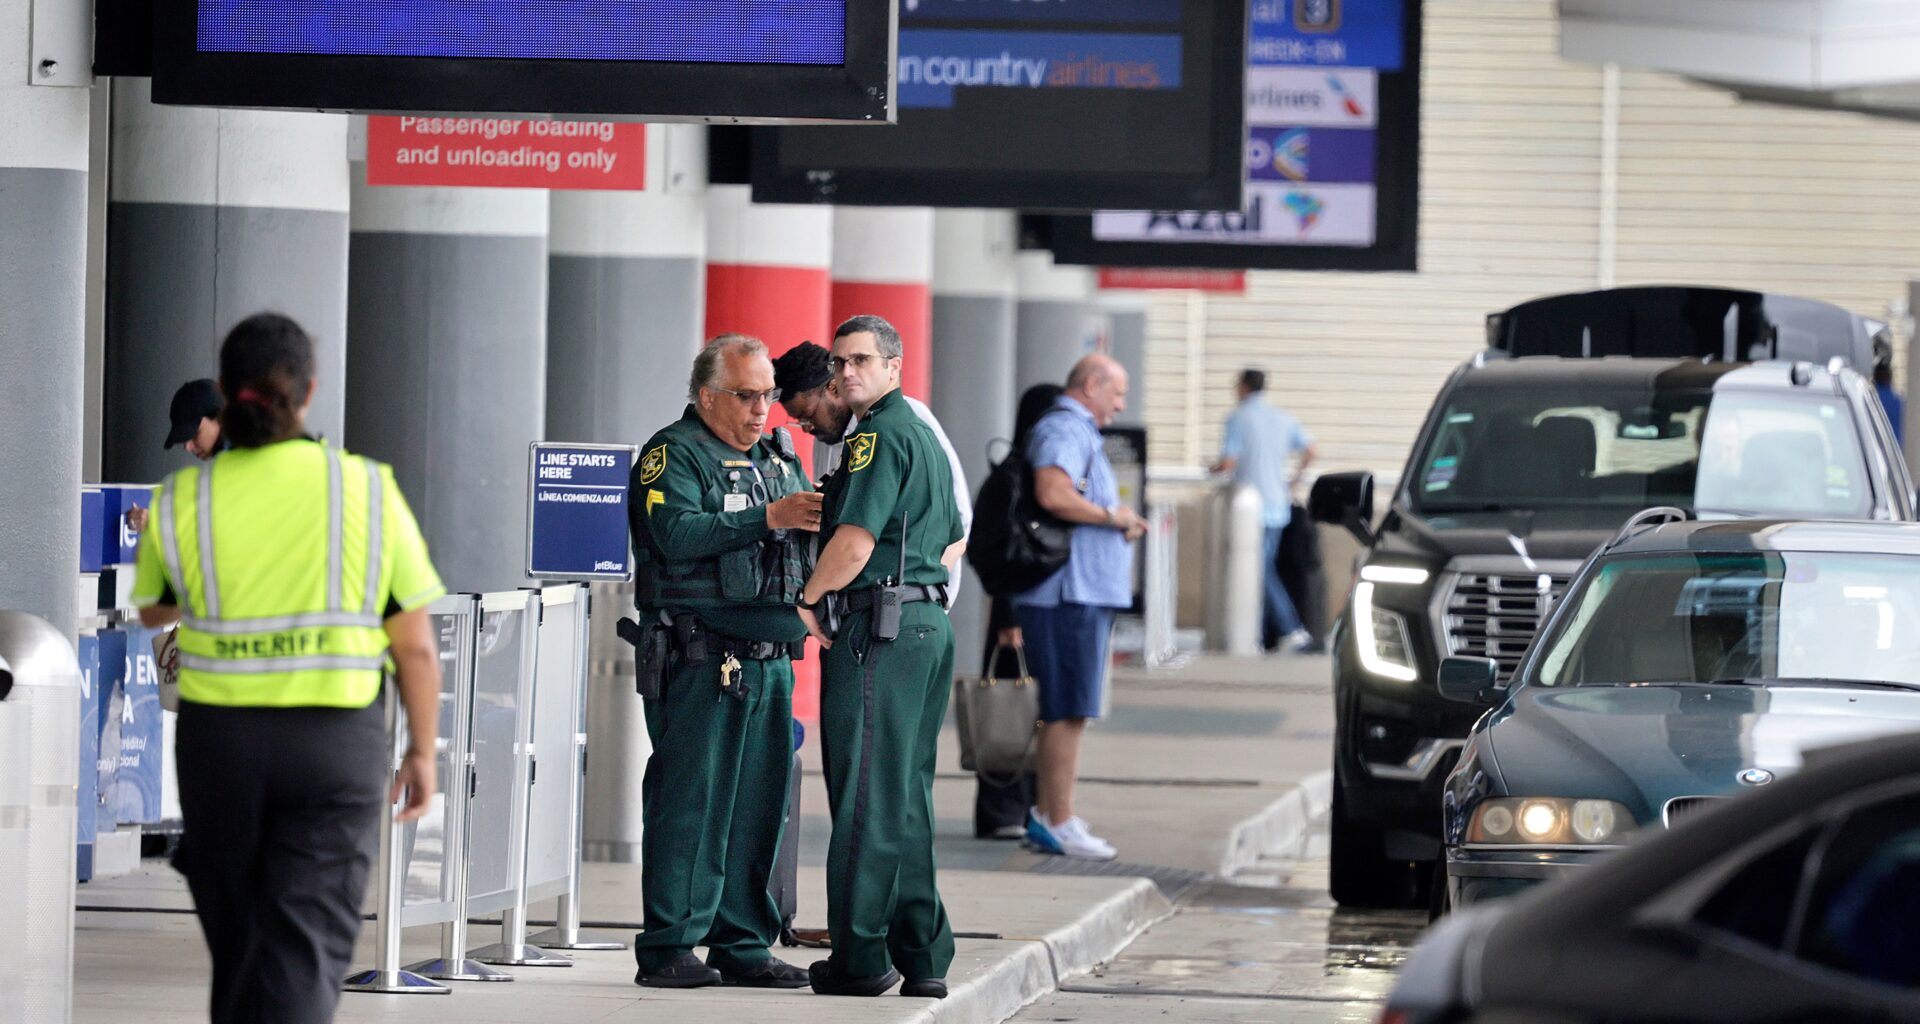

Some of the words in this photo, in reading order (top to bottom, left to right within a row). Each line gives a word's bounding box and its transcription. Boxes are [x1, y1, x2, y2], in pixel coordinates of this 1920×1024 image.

[401, 116, 523, 140] Passenger
[529, 120, 614, 142] loading
[396, 145, 440, 165] and
[446, 147, 560, 172] unloading
[567, 148, 617, 173] only
[540, 453, 568, 466] LINE
[569, 454, 616, 467] STARTS
[539, 467, 572, 479] HERE
[538, 491, 562, 502] LÍNEA
[562, 493, 602, 503] COMIENZA
[594, 560, 623, 571] jetBlue
